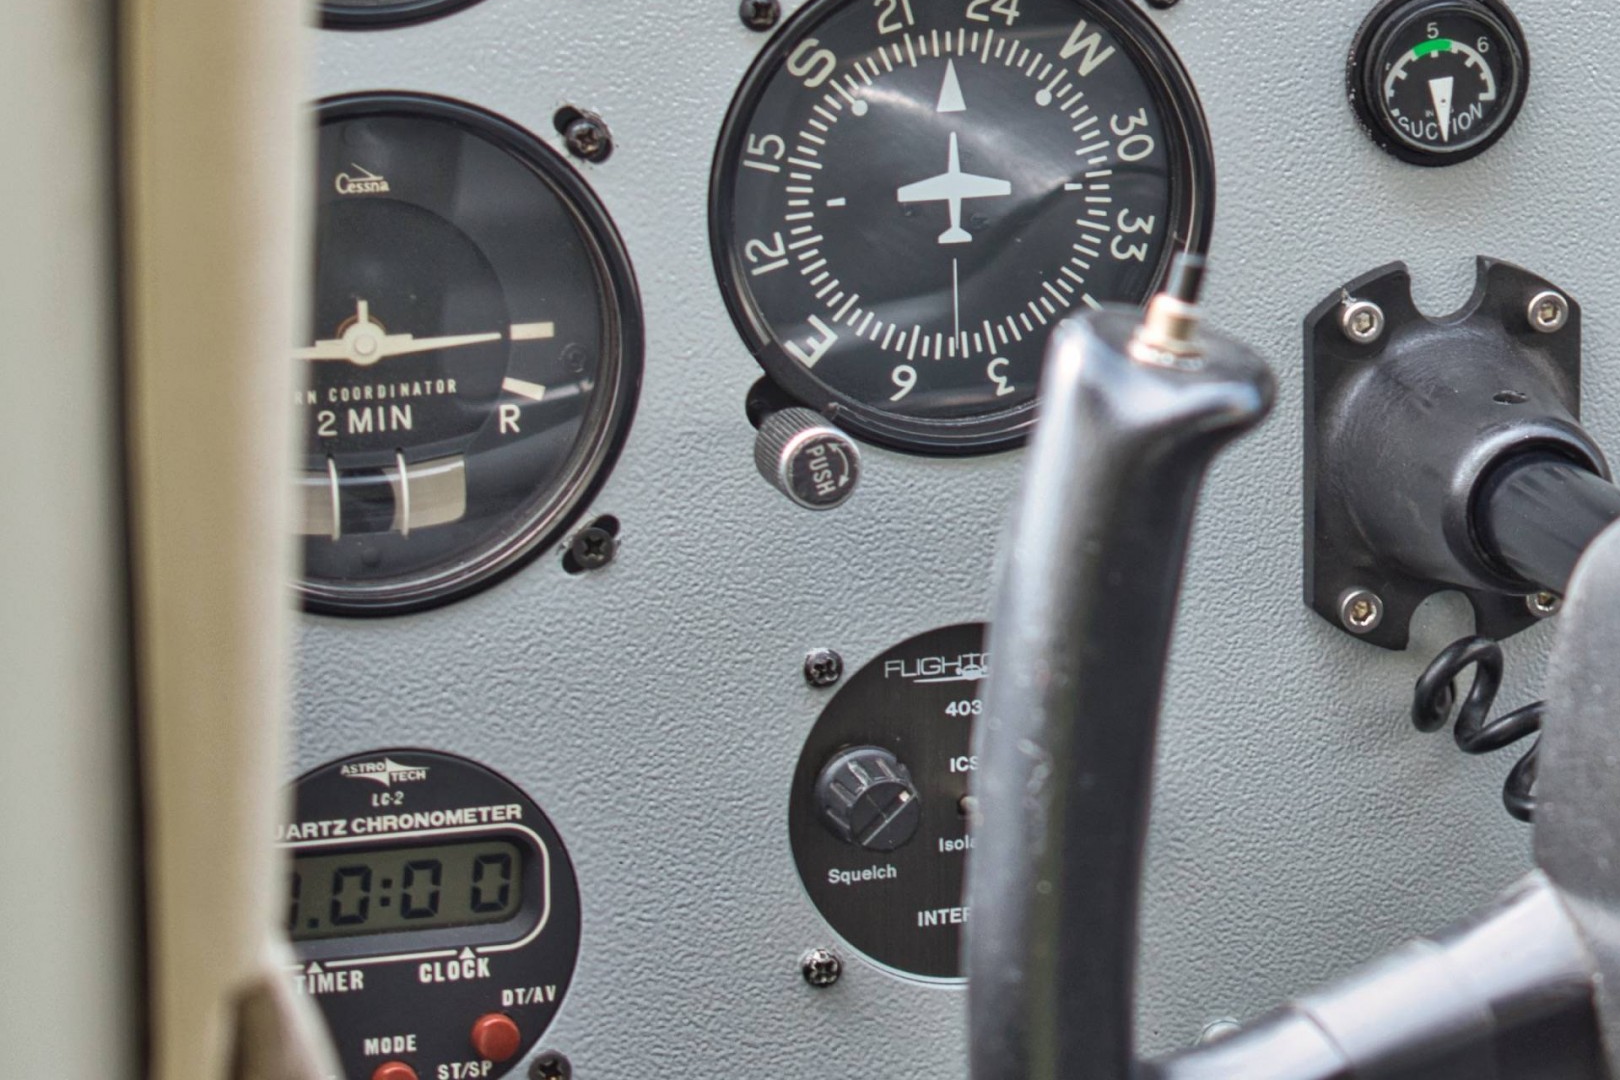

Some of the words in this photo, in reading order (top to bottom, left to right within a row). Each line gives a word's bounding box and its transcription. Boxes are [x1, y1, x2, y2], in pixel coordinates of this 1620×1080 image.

[1427, 22, 1439, 39] 5
[1477, 36, 1489, 52] 6
[786, 38, 837, 88] S
[1110, 108, 1154, 161] 30
[1398, 103, 1483, 140] SUCION
[743, 133, 785, 172] 15
[335, 174, 390, 194] Cessna
[1110, 209, 1155, 262] 33
[744, 232, 789, 276] 12
[784, 314, 838, 368] E
[891, 364, 918, 401] 6
[986, 358, 1015, 396] 3
[329, 380, 457, 401] COORDINATOR
[318, 412, 336, 436] 2
[349, 405, 413, 433] MIN
[500, 405, 520, 432] R
[805, 444, 835, 497] PUSH
[945, 700, 982, 716] 403
[340, 762, 384, 775] ASTRO
[391, 769, 426, 781] TECH
[372, 792, 404, 806] LC-2
[351, 804, 522, 833] CHRONOMETER
[828, 865, 897, 883] Squelch
[297, 970, 364, 994] TIMER
[419, 958, 491, 983] CLOCK
[502, 985, 556, 1006] DT/AV
[364, 1035, 416, 1055] MODE
[438, 1060, 493, 1080] ST/SP
